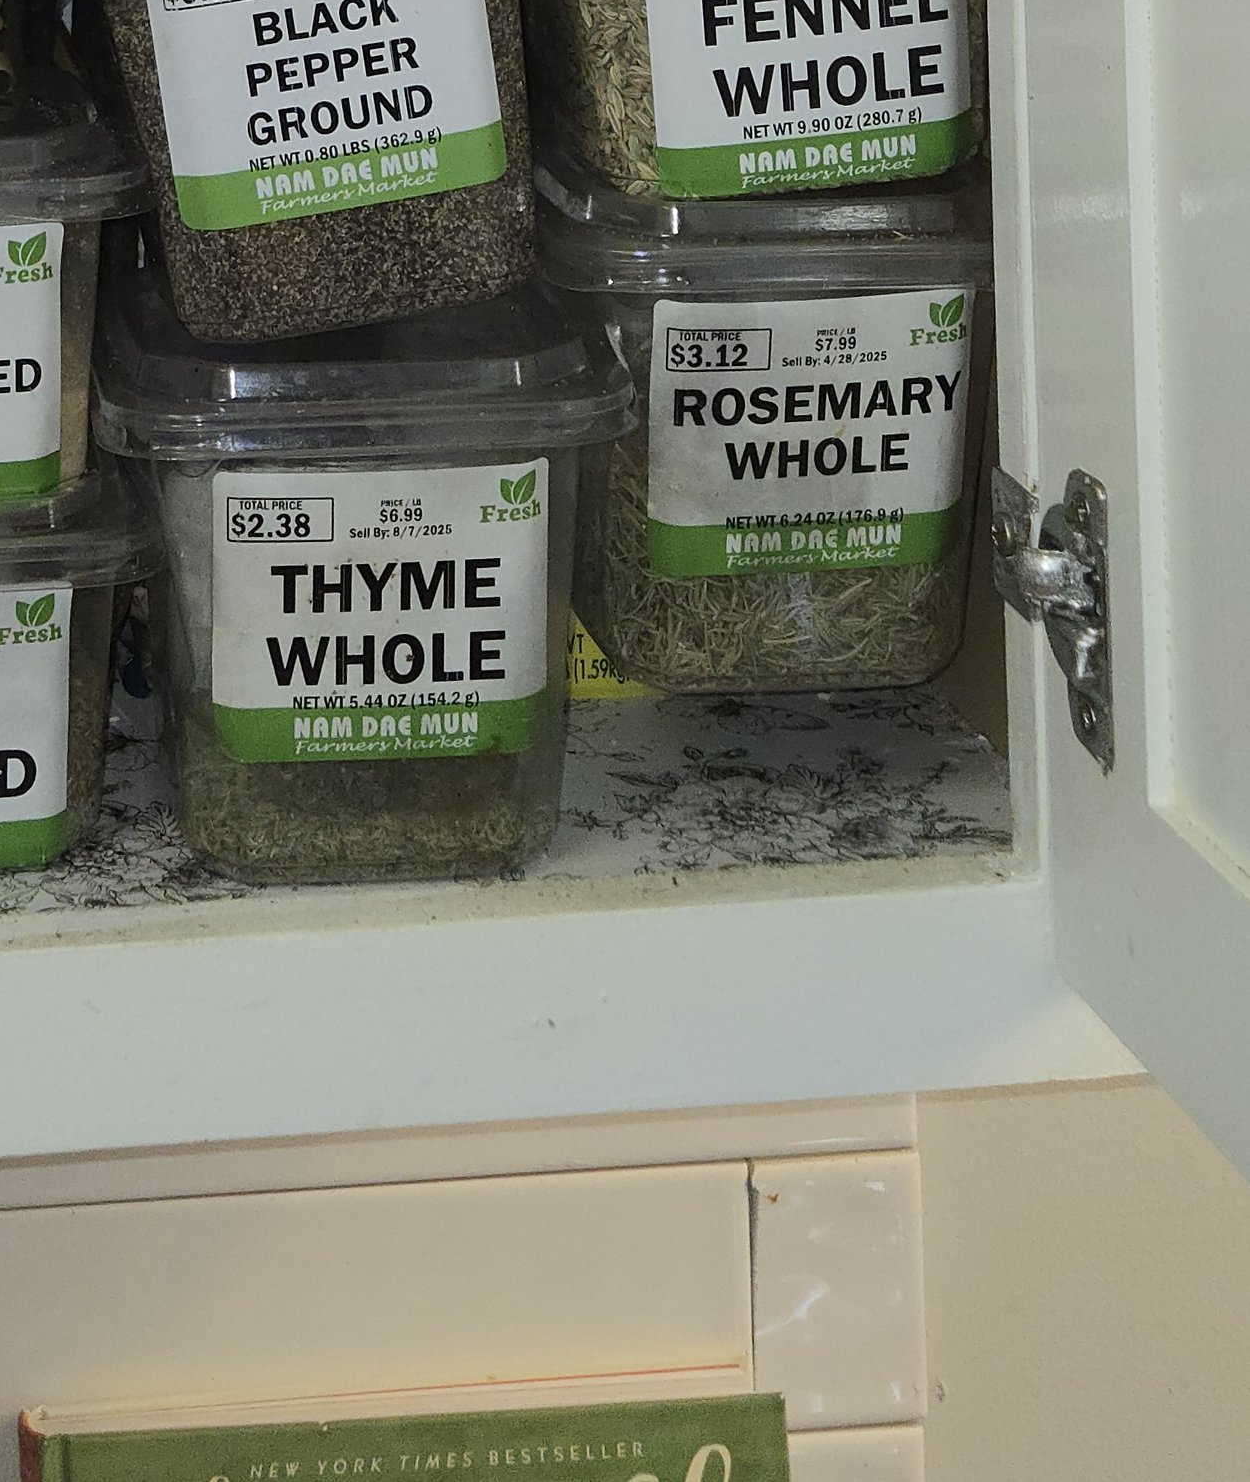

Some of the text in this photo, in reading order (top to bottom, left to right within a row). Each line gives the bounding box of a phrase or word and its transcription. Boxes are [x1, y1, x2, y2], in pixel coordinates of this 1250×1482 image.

[245, 37, 419, 97] PEPPER
[712, 44, 945, 118] WHOLE
[247, 85, 433, 146] GROUND
[815, 336, 857, 352] $7.99
[909, 325, 967, 346] Fresh
[670, 344, 748, 369] $3.12
[823, 350, 887, 366] 4/28/2025
[673, 370, 961, 427] ROSEMARY
[725, 433, 909, 480] WHOLE
[239, 500, 302, 510] TOTAL PRICE
[380, 507, 423, 523] $6.99
[479, 503, 541, 524] Fresh
[231, 513, 311, 538] $2.38
[271, 558, 501, 615] THYME
[266, 630, 506, 687] WHOLE
[292, 691, 480, 710] NET WT 5.44 OZ (154.2 g)
[293, 712, 478, 738] NAM DAE MUN
[295, 734, 478, 755] Farmers Market
[250, 1442, 646, 1480] NEW YORK TIMES BESTSELLER
